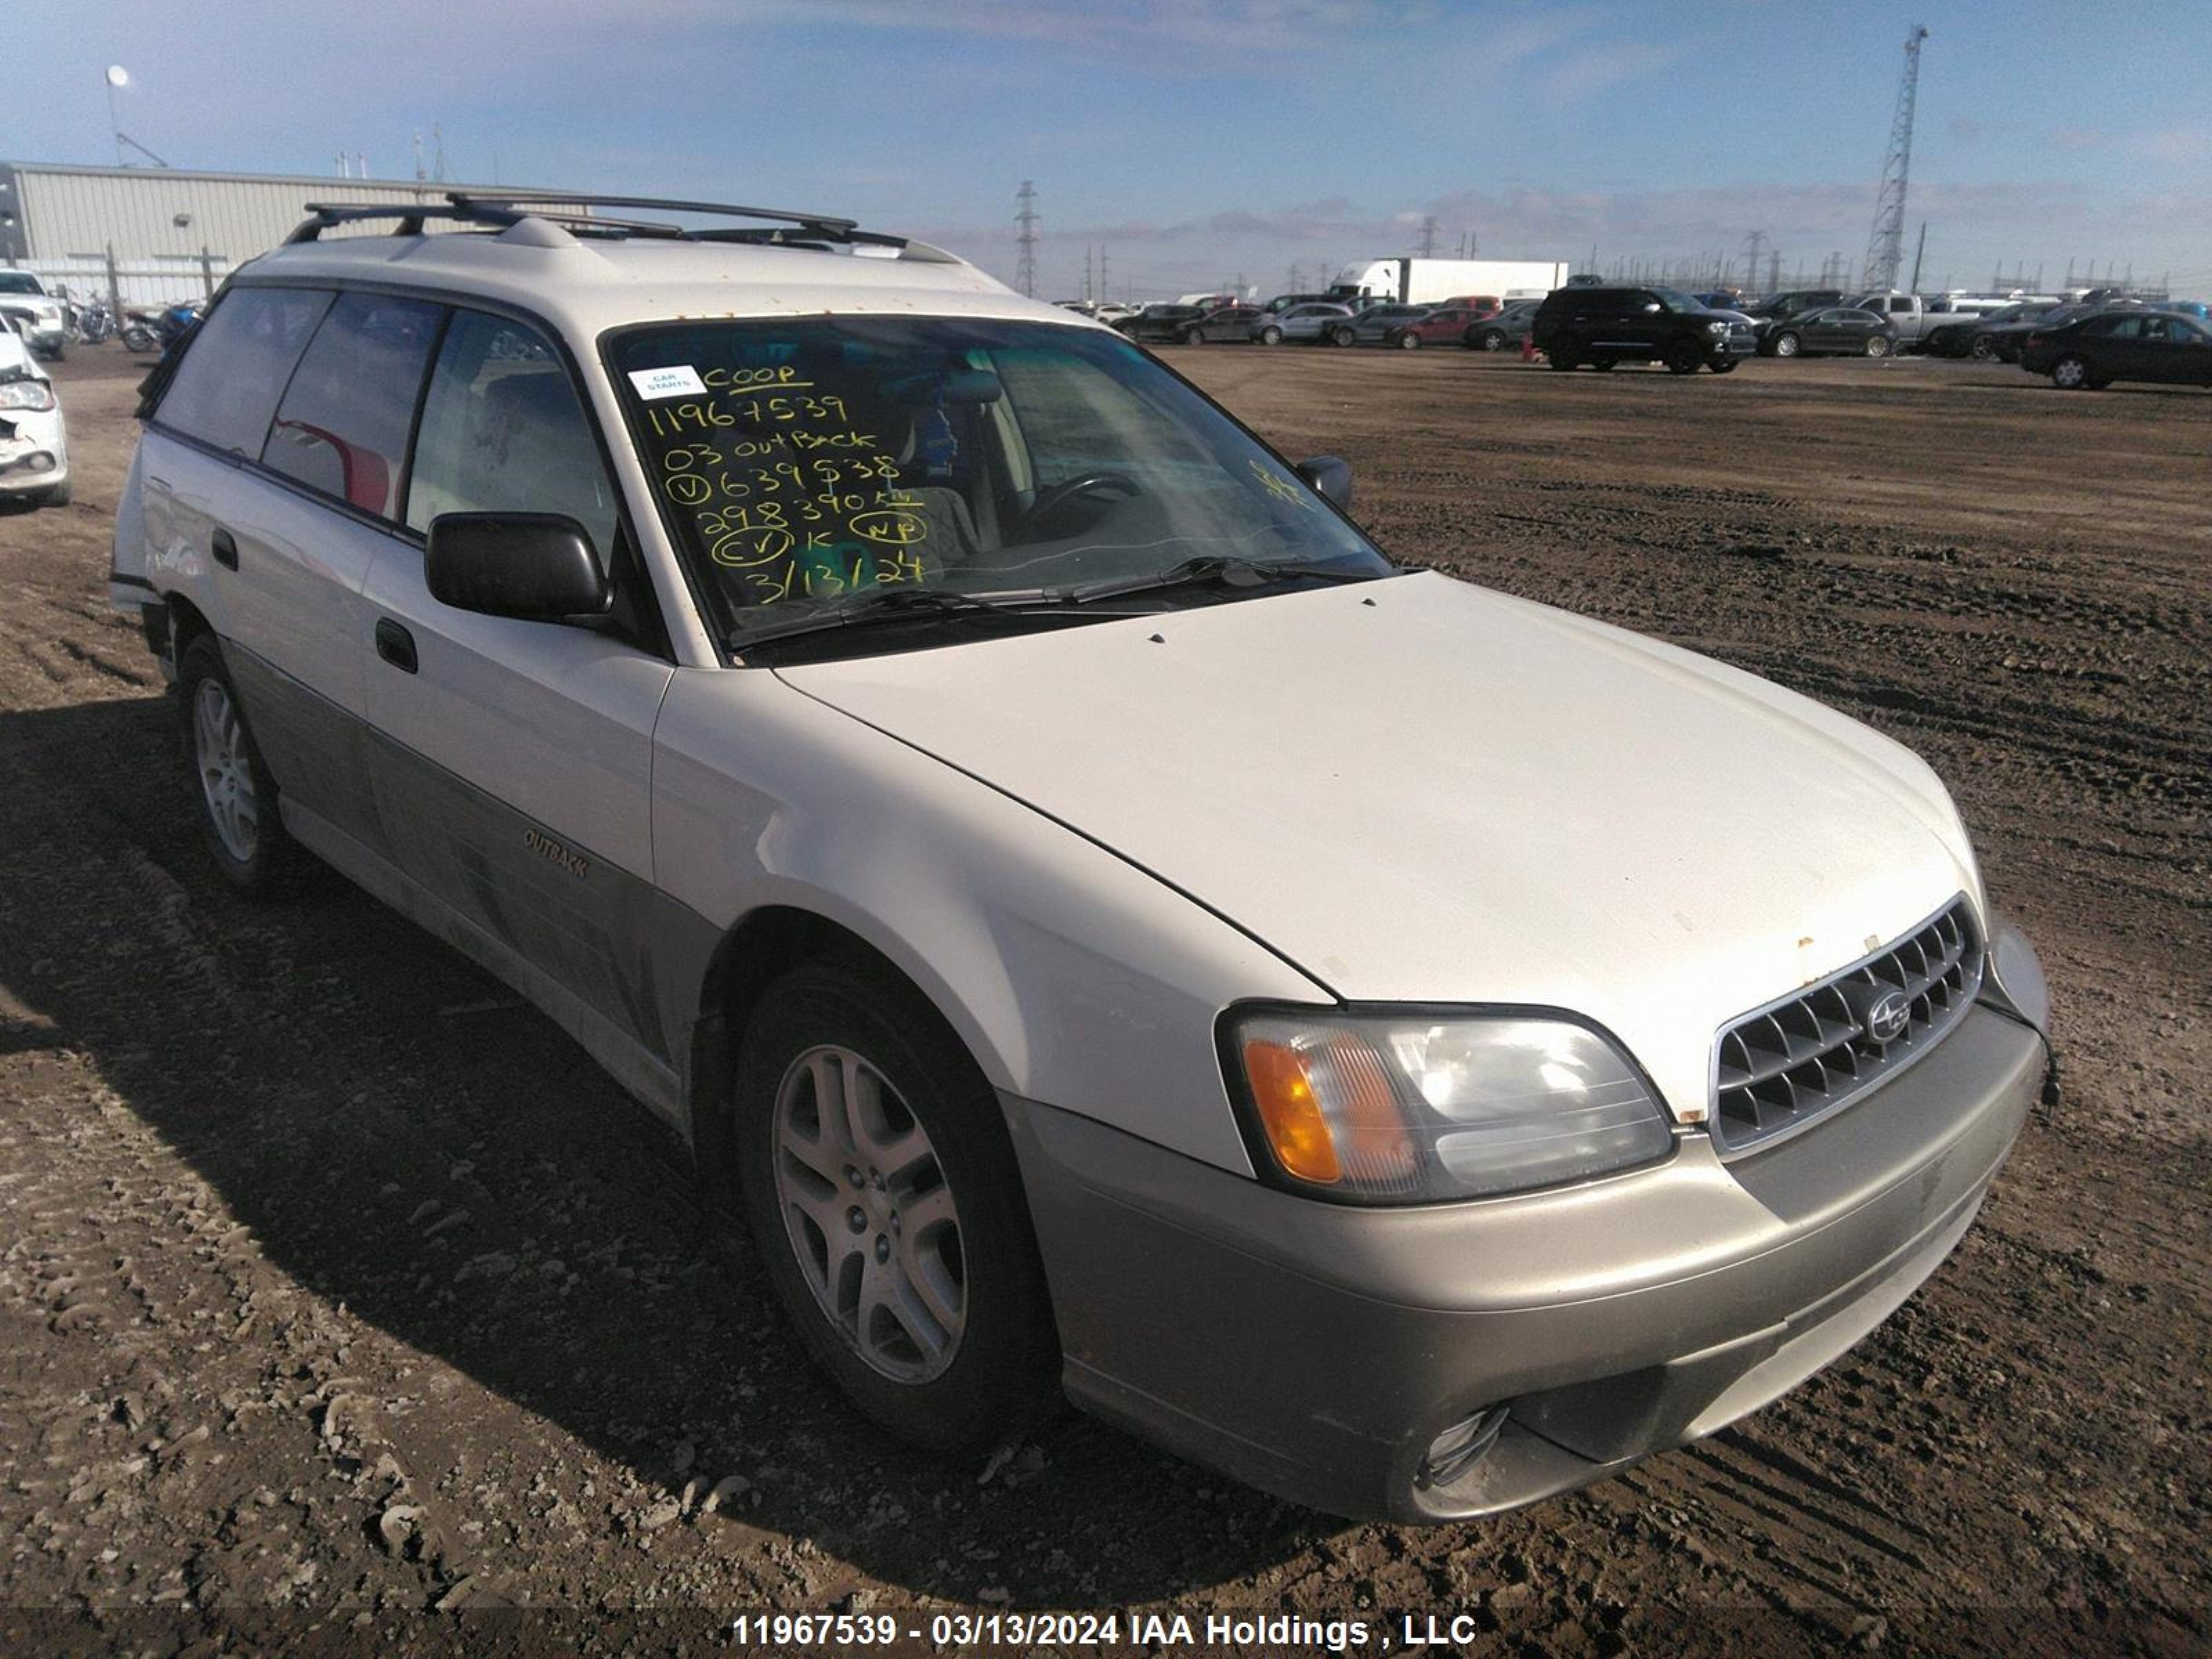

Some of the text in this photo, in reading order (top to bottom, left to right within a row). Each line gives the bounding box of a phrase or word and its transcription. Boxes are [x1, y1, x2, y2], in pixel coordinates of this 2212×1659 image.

[648, 395, 847, 436] 11967539
[664, 444, 722, 471] 03
[524, 829, 587, 877] OUTBACK
